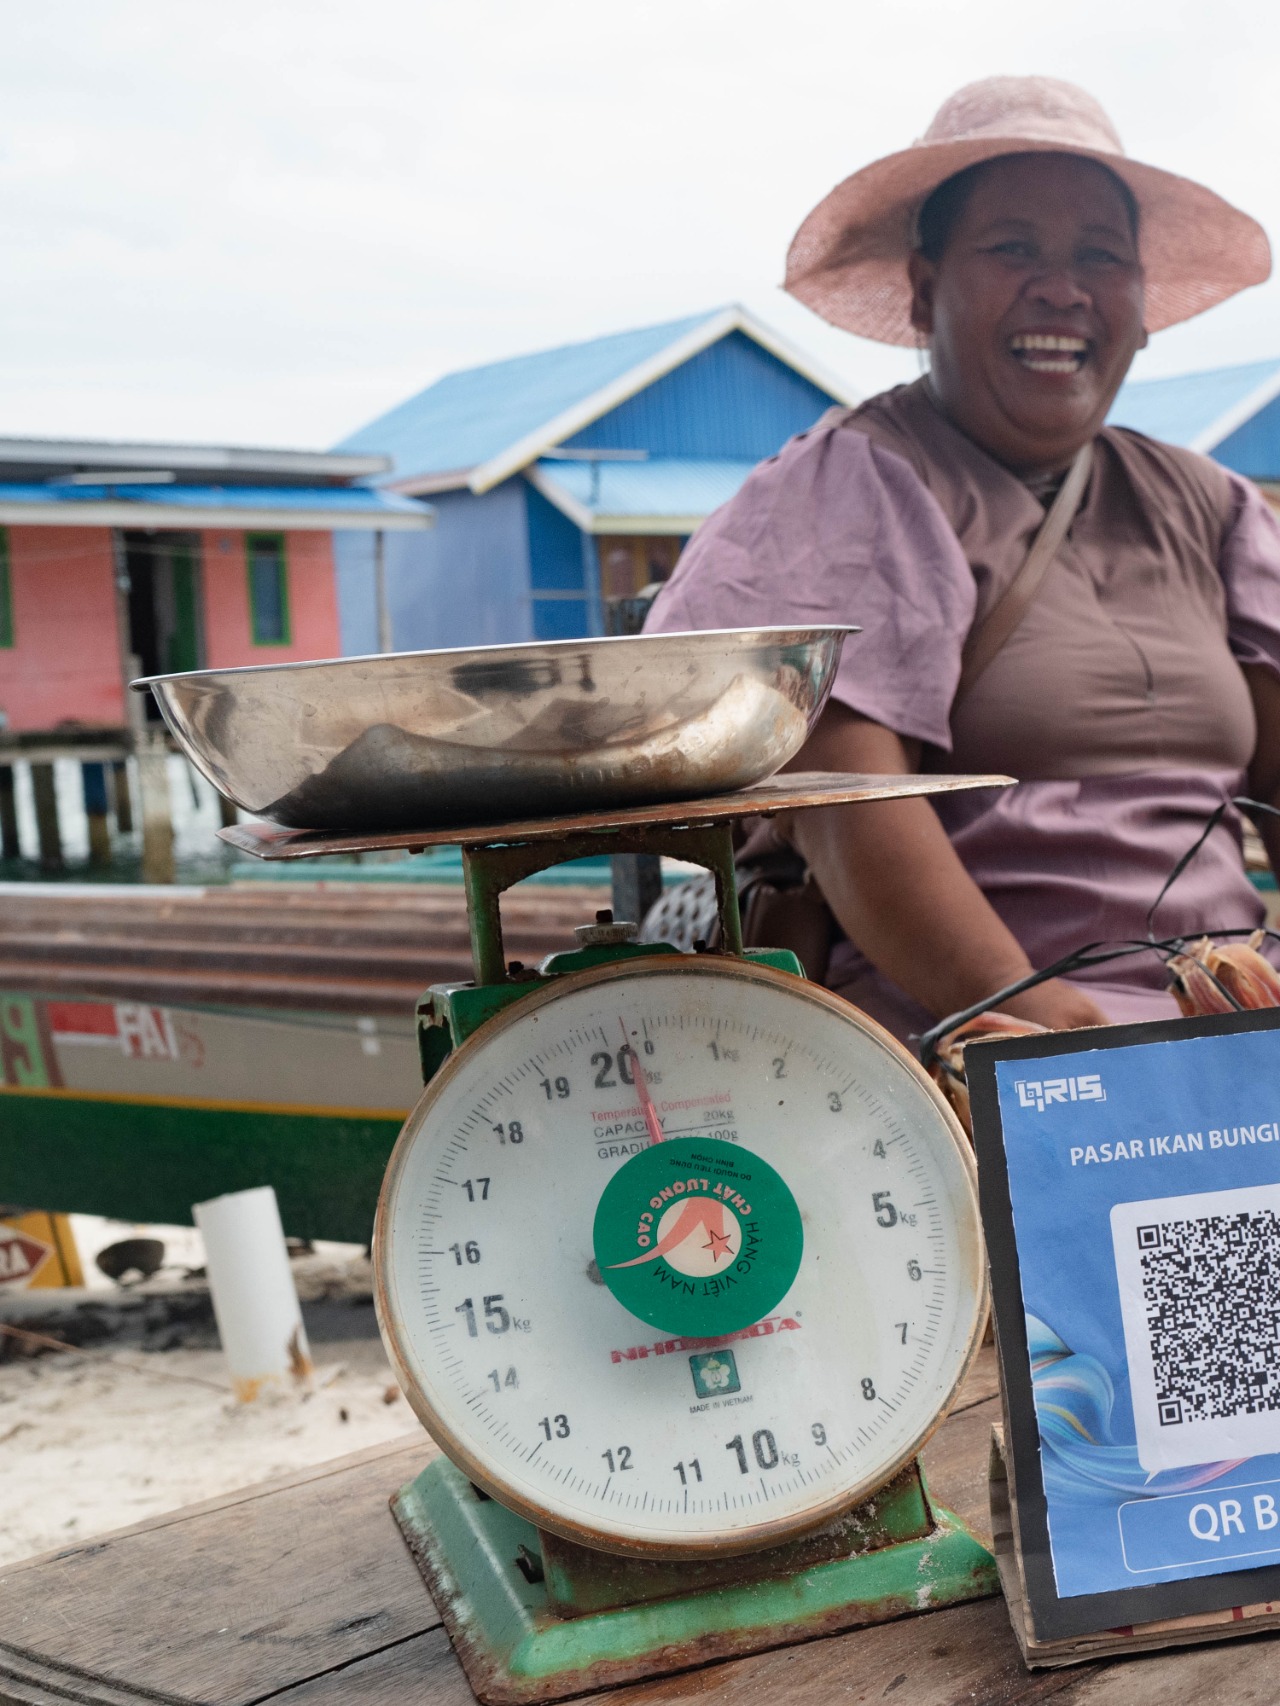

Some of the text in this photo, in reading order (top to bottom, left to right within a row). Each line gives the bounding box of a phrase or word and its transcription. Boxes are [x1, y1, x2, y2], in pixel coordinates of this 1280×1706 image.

[644, 1040, 655, 1055] 0
[772, 1057, 787, 1079] 2
[539, 1076, 570, 1100] 19
[1016, 1075, 1106, 1112] QRIS
[827, 1091, 842, 1113] 3
[492, 1121, 524, 1145] 18
[594, 1109, 736, 1139] CAPACIY 20kg
[873, 1138, 888, 1159] 4
[1070, 1138, 1145, 1166] PASAR
[1149, 1131, 1205, 1157] IKAN
[461, 1177, 491, 1202] 17
[636, 1212, 654, 1247] CAO
[449, 1240, 481, 1266] 16
[652, 1265, 695, 1296] NAM
[907, 1259, 922, 1282] 6
[895, 1322, 908, 1345] 7
[487, 1366, 520, 1393] 14
[860, 1377, 876, 1401] 8
[689, 1395, 753, 1414] MADE IN VIETNAM
[538, 1414, 571, 1441] 13
[811, 1422, 827, 1446] 9
[601, 1446, 634, 1473] 12
[673, 1458, 703, 1485] 11
[1188, 1502, 1245, 1543] QR
